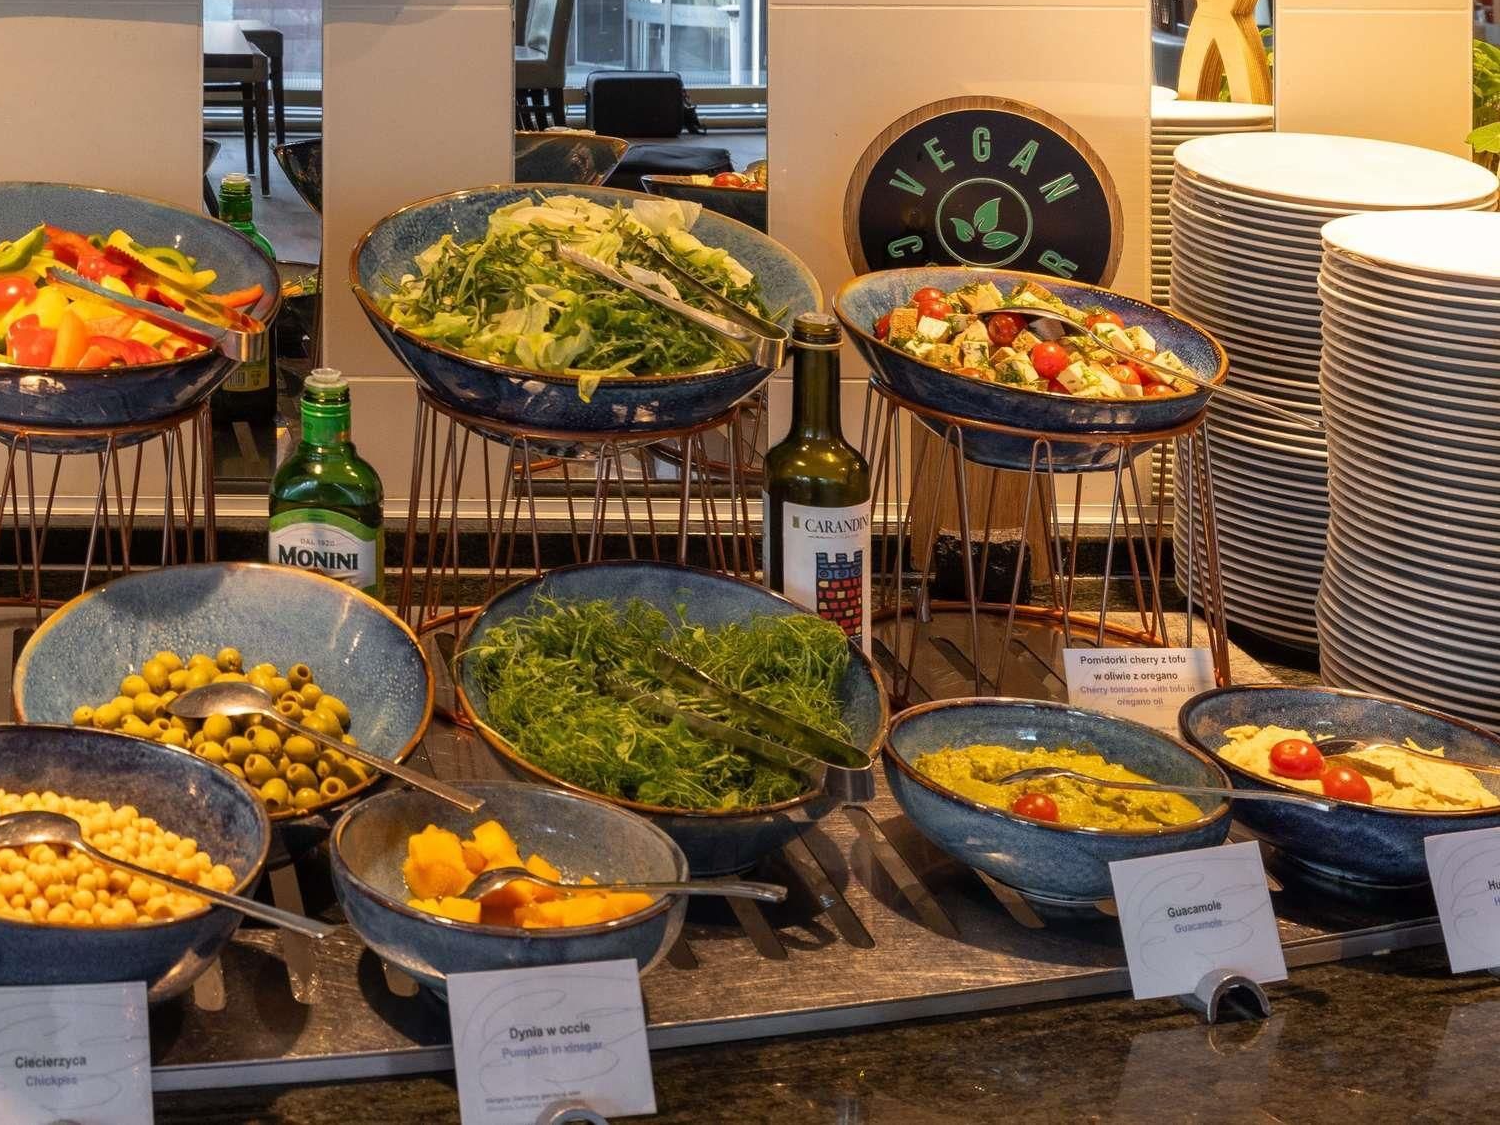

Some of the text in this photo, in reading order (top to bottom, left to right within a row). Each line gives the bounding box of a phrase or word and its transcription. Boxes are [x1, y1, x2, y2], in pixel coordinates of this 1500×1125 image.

[888, 126, 1080, 204] VEGAN
[278, 544, 359, 571] MONINI
[1080, 655, 1128, 665] Pomidorki
[1129, 655, 1159, 666] cherry
[1168, 655, 1186, 664] tofu
[1093, 673, 1102, 681] w
[1140, 673, 1178, 682] oregano
[1167, 900, 1222, 918] Guacamole
[509, 1021, 591, 1042] Dynia w occie
[14, 1054, 88, 1070] Ciecierzyca
